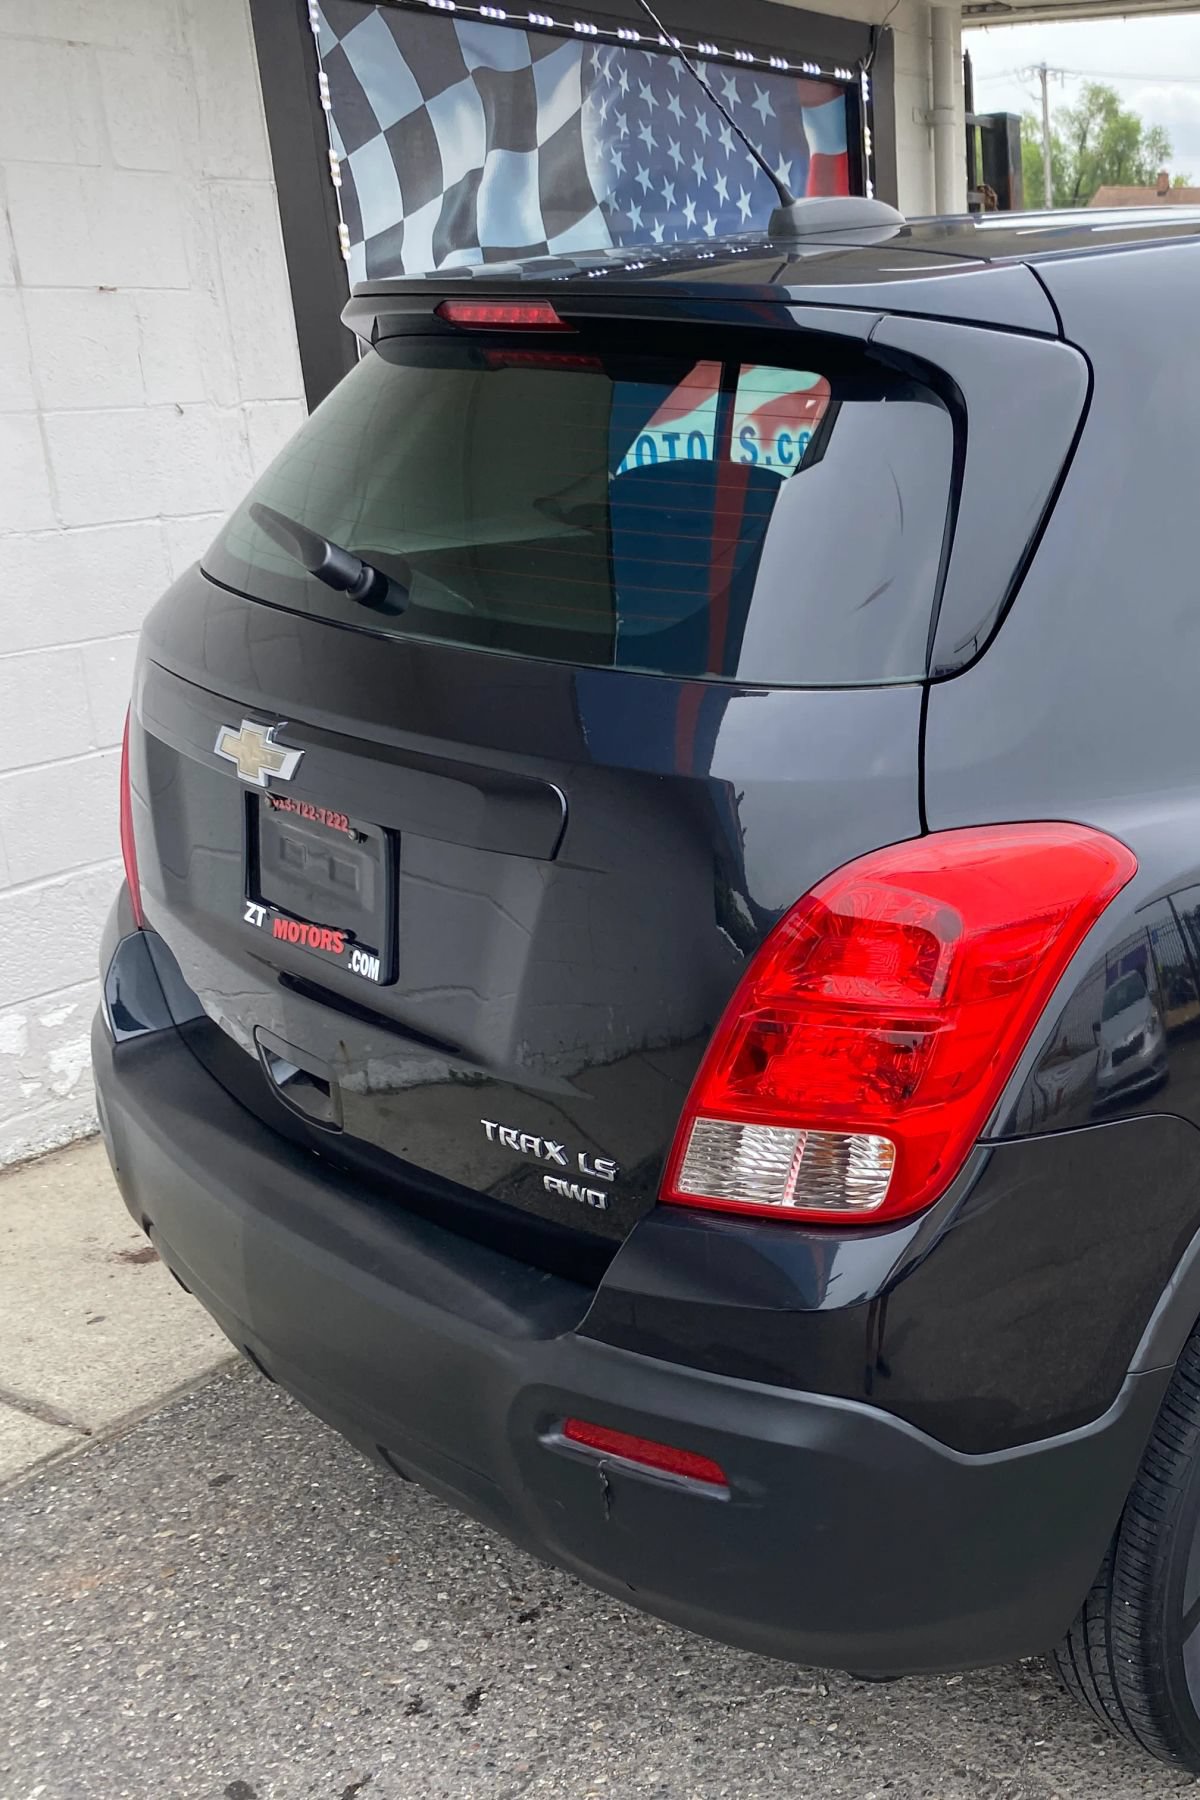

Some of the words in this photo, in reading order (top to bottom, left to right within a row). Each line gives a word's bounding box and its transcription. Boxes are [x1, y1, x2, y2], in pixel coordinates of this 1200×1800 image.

[244, 900, 266, 927] ZT
[273, 918, 345, 954] MOTORS
[348, 949, 380, 981] .COM
[480, 1119, 569, 1166] TRAX
[578, 1152, 617, 1182] LS
[543, 1175, 608, 1210] AWD
